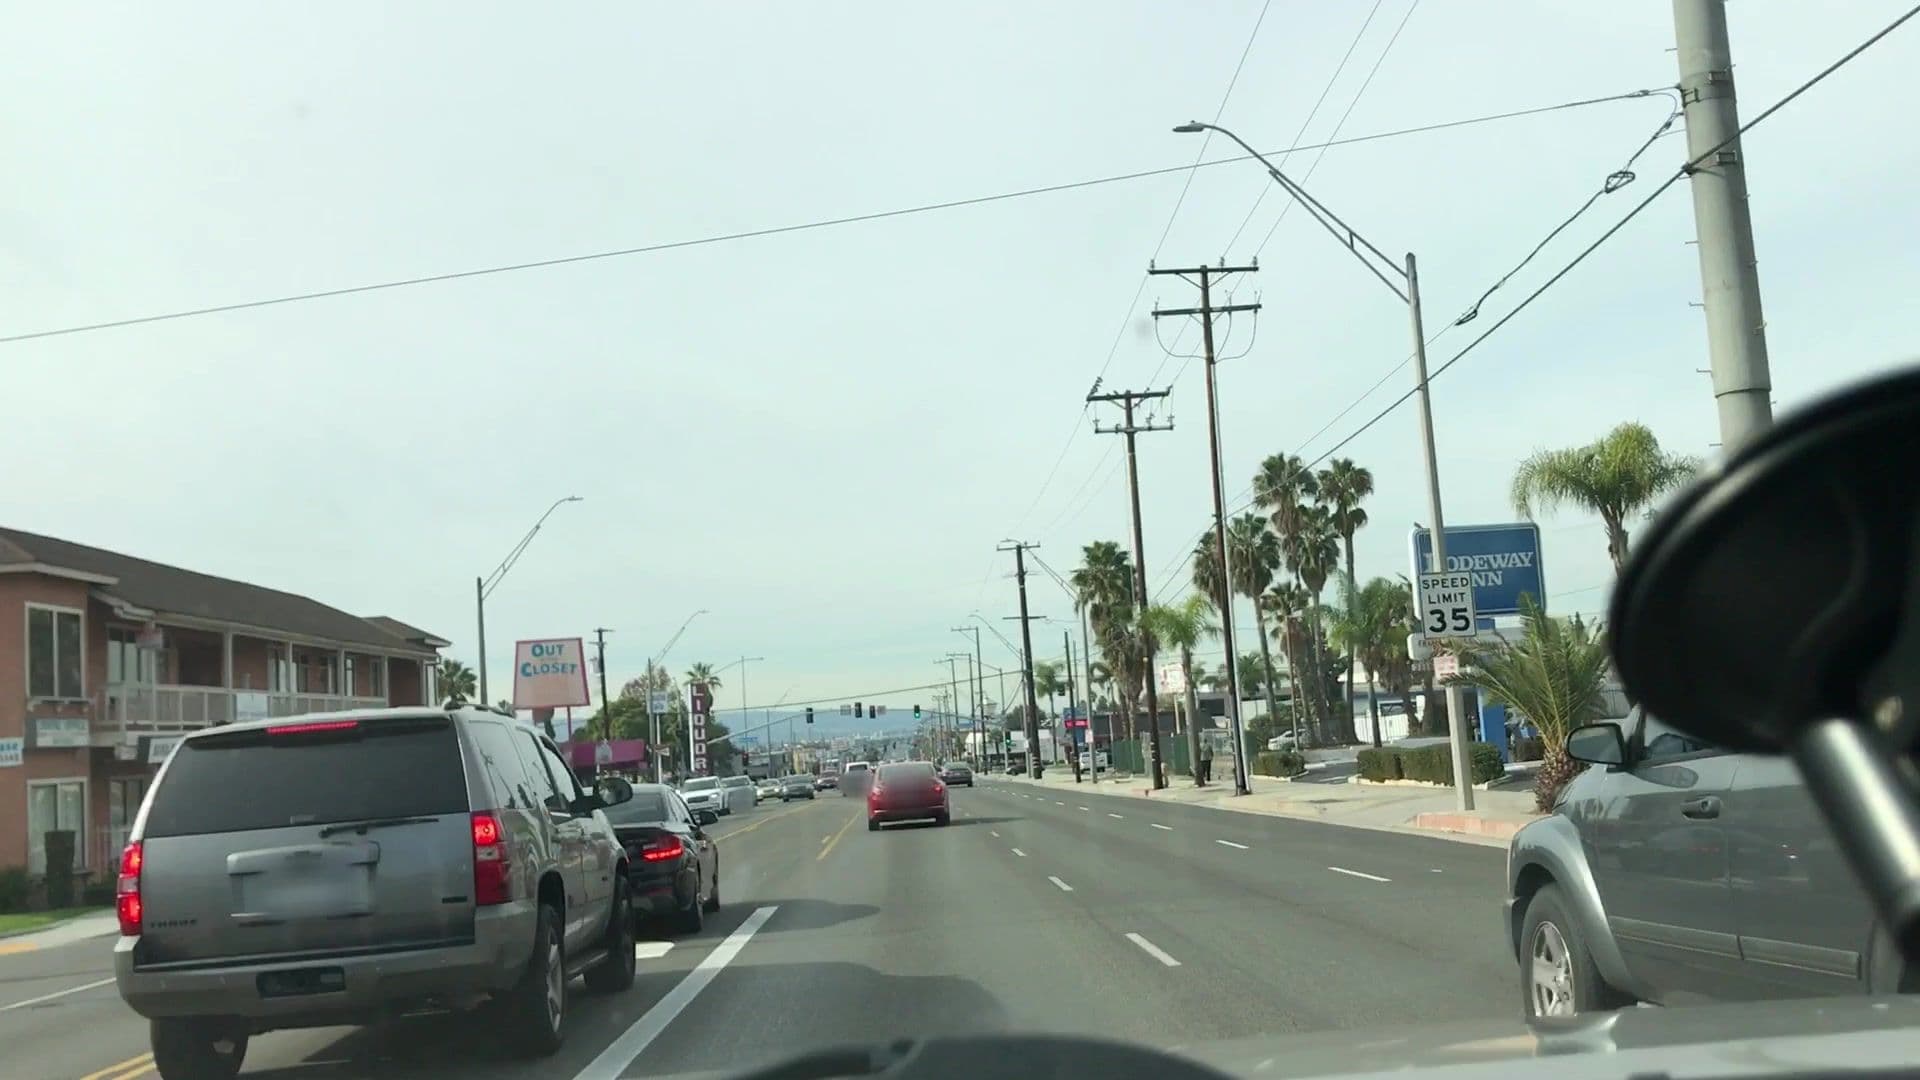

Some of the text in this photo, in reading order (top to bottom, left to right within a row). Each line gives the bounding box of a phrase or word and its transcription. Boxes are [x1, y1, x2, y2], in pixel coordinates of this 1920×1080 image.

[1422, 577, 1470, 590] SPEED
[1427, 592, 1466, 605] LIMIT
[1428, 607, 1471, 633] 35
[531, 642, 565, 657] OUT
[520, 661, 578, 678] CLOSET
